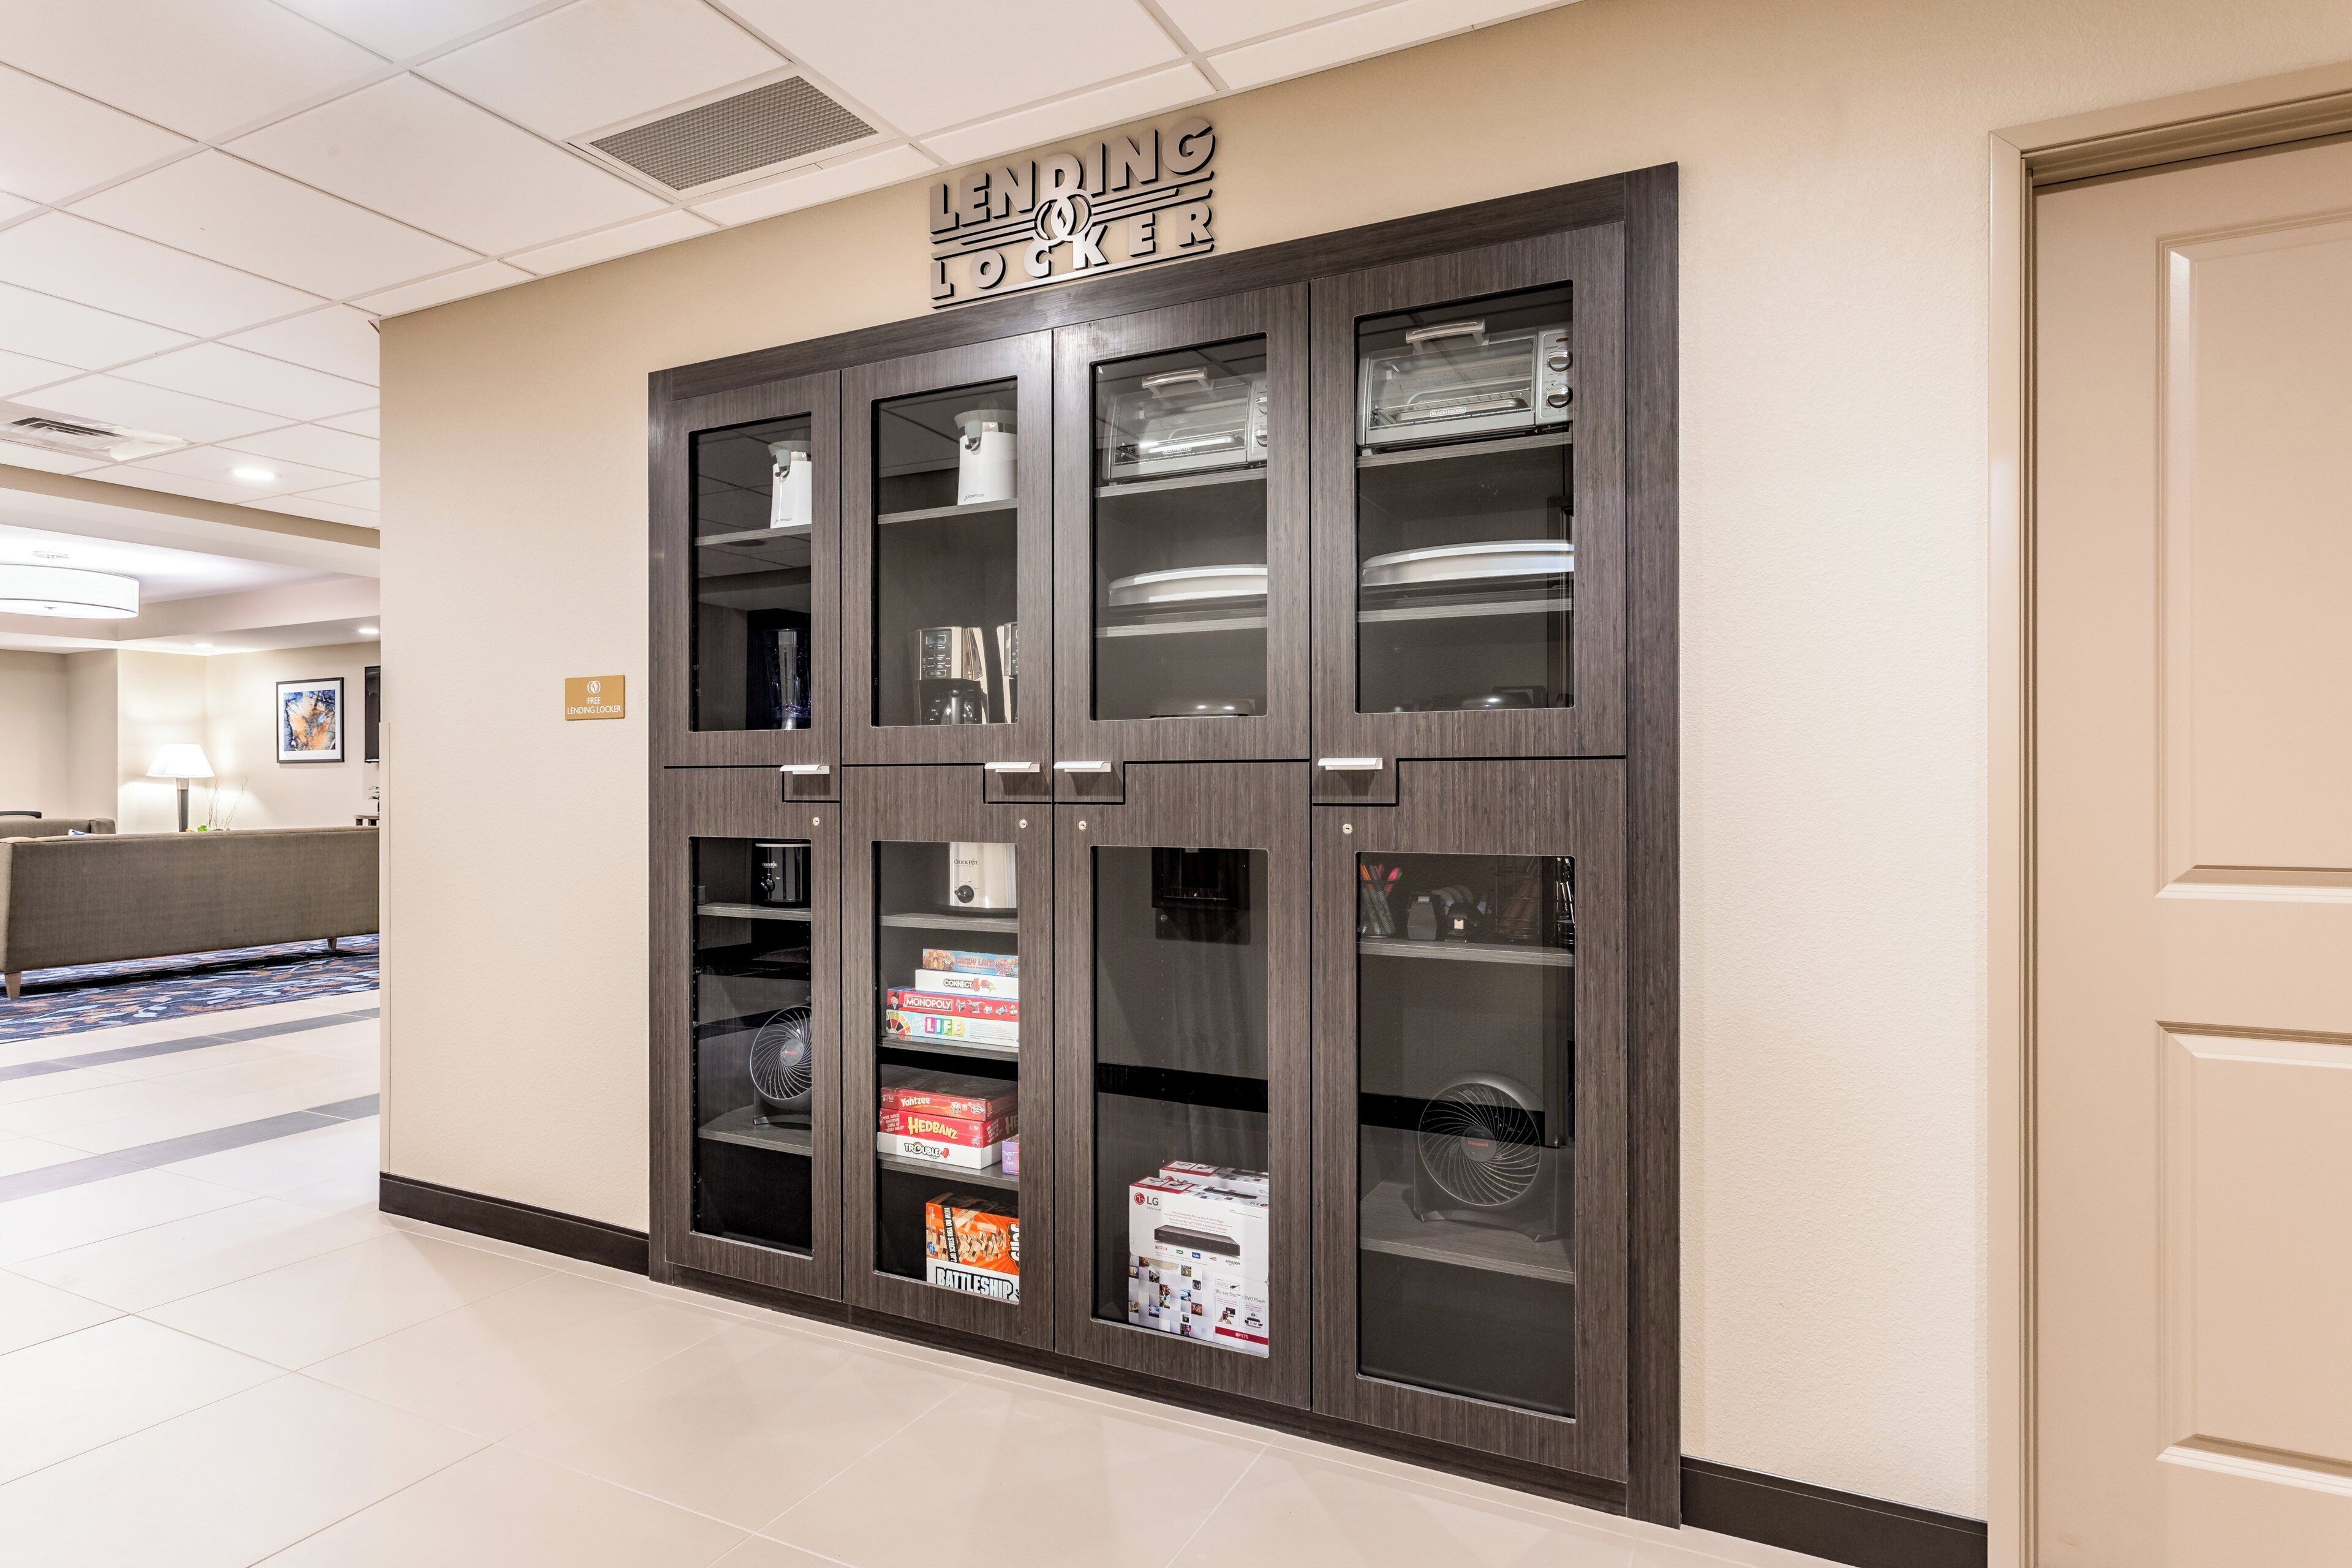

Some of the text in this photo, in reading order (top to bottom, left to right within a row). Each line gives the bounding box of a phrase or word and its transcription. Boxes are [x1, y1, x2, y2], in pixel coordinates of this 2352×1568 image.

[929, 116, 1216, 235] LENDING
[930, 202, 1215, 301] LOCKER
[567, 705, 622, 715] LENDING LOCKER
[943, 978, 980, 991] CONNECT 4
[906, 998, 951, 1010] MONOPOLY
[926, 1017, 962, 1036] LIFE
[900, 1096, 930, 1107] Yahtzee
[907, 1116, 959, 1140] HEDBANZ
[904, 1142, 940, 1157] TROUBLE
[1147, 1196, 1159, 1206] LG
[936, 1267, 1012, 1300] BATTLESHIP
